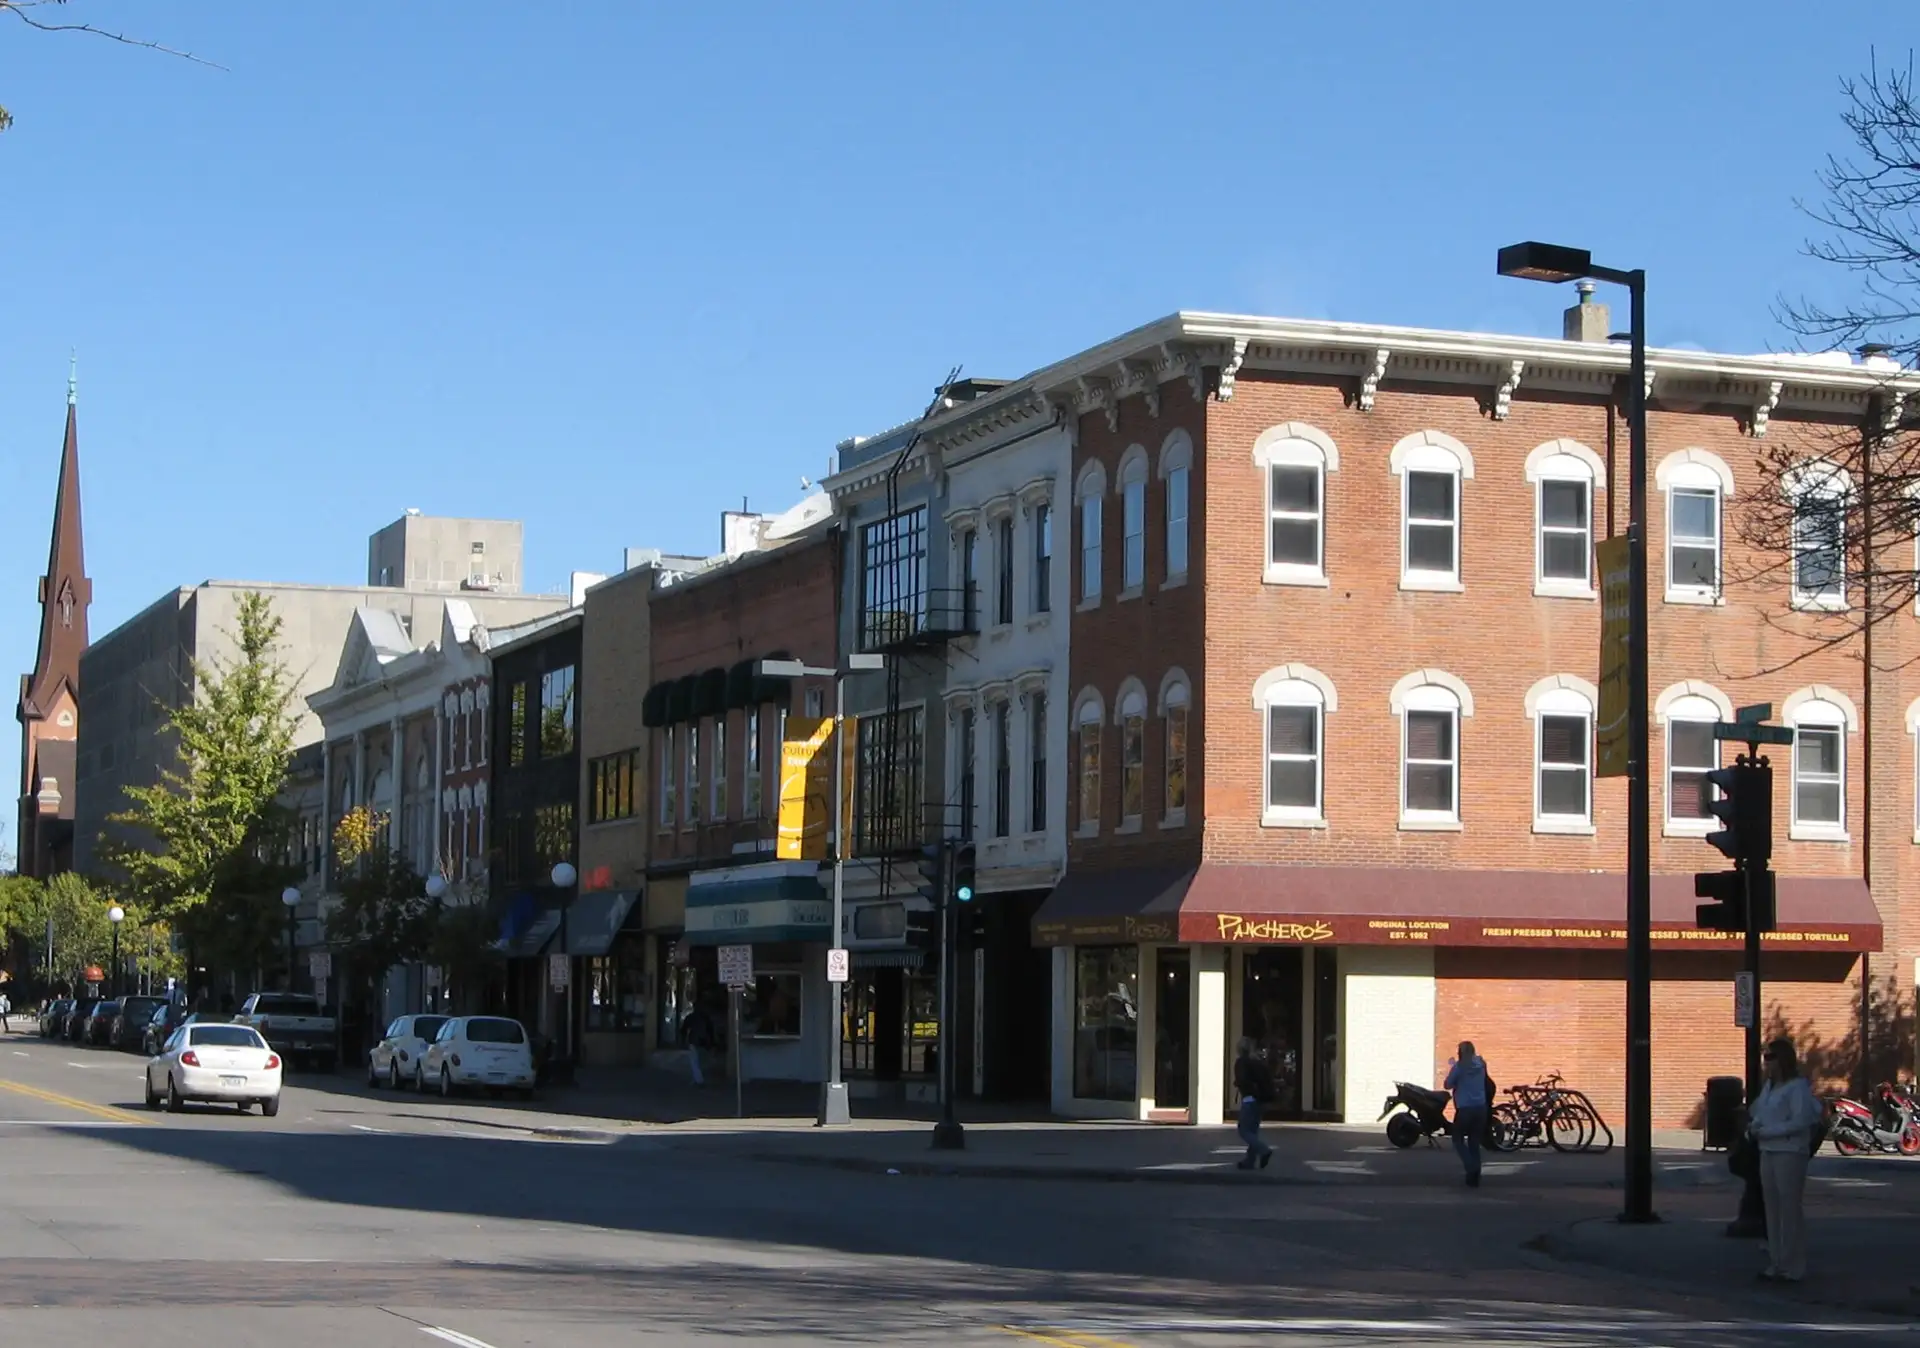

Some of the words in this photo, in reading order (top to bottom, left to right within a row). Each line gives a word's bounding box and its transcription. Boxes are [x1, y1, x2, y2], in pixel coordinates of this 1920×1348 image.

[1217, 914, 1333, 940] PANCHERO'S
[1368, 921, 1407, 929] ORIGINAL
[1409, 921, 1449, 930] LOCATION
[1482, 928, 1511, 936] FRESH
[1514, 928, 1553, 937] PRESSED
[1554, 929, 1602, 938] TORTILLAS
[1610, 930, 1628, 939] FRE
[1649, 931, 1680, 939] ESSED
[1681, 931, 1727, 940] TORTILLAS
[1764, 932, 1803, 941] PRESSED
[1804, 933, 1849, 942] TORTILLAS
